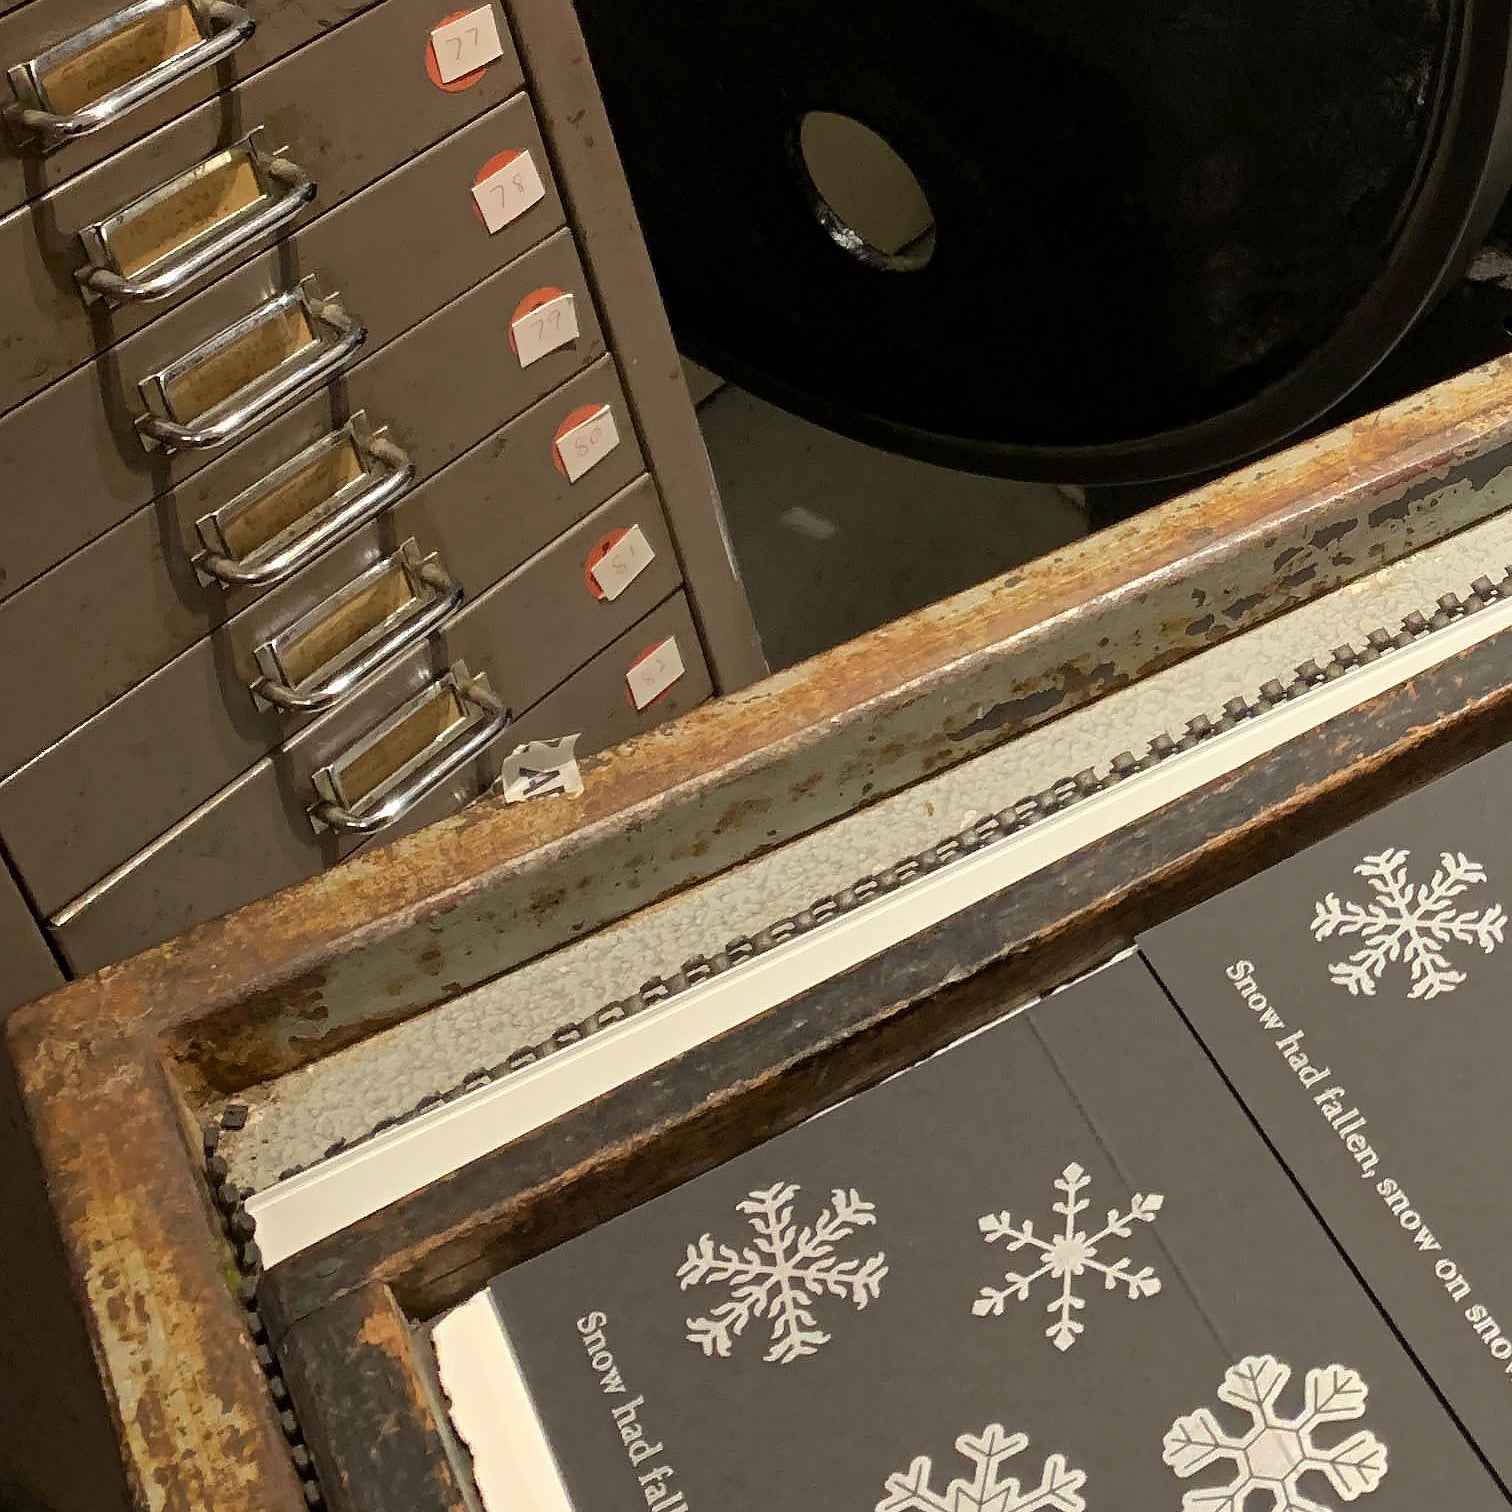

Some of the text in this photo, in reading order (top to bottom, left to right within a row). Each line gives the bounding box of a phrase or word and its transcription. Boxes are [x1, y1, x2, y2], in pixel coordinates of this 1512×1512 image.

[444, 26, 479, 61] 77
[488, 171, 525, 208] 78
[528, 309, 562, 341] 79
[574, 427, 603, 458] 80
[610, 544, 636, 575] 81
[641, 658, 668, 686] 82
[1225, 960, 1286, 1030] Snow
[1275, 1030, 1332, 1090] had
[1313, 1086, 1380, 1179] fallen,
[1376, 1177, 1442, 1251] snow
[1434, 1258, 1472, 1303] on
[576, 1311, 627, 1394] Snow
[611, 1393, 664, 1467] had
